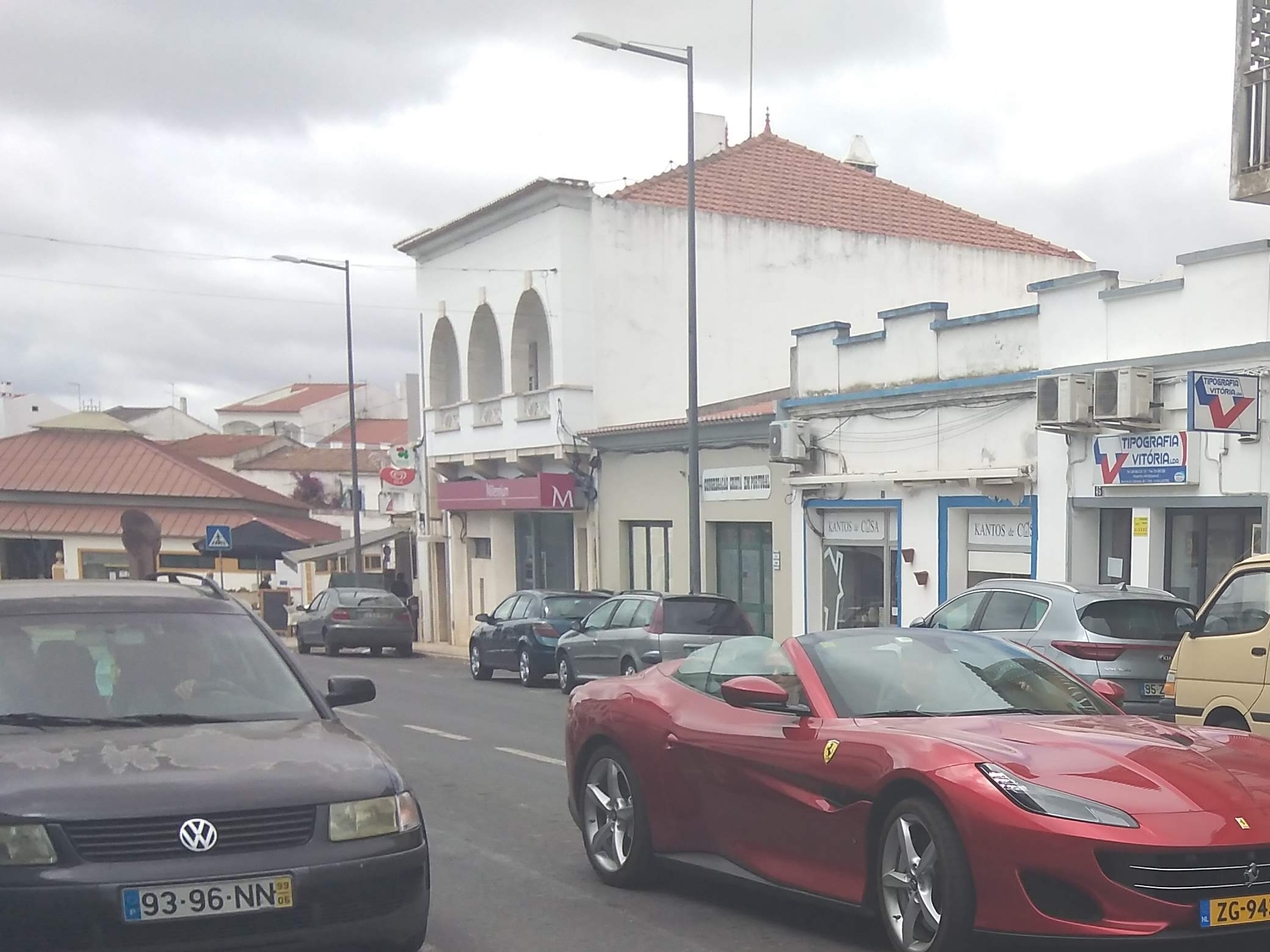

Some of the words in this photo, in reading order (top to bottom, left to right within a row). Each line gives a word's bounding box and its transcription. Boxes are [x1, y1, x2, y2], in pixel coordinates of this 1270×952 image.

[1203, 377, 1239, 387] TIPOGRAFIA
[1209, 386, 1236, 395] VITÓRIA
[1121, 435, 1179, 449] TIPOGRAFIA
[1132, 449, 1170, 465] VITÓRIA
[551, 485, 574, 508] M
[828, 519, 853, 533] KANTOS
[974, 522, 1006, 537] KANTOS
[1145, 684, 1156, 695] 95
[277, 896, 290, 905] 06
